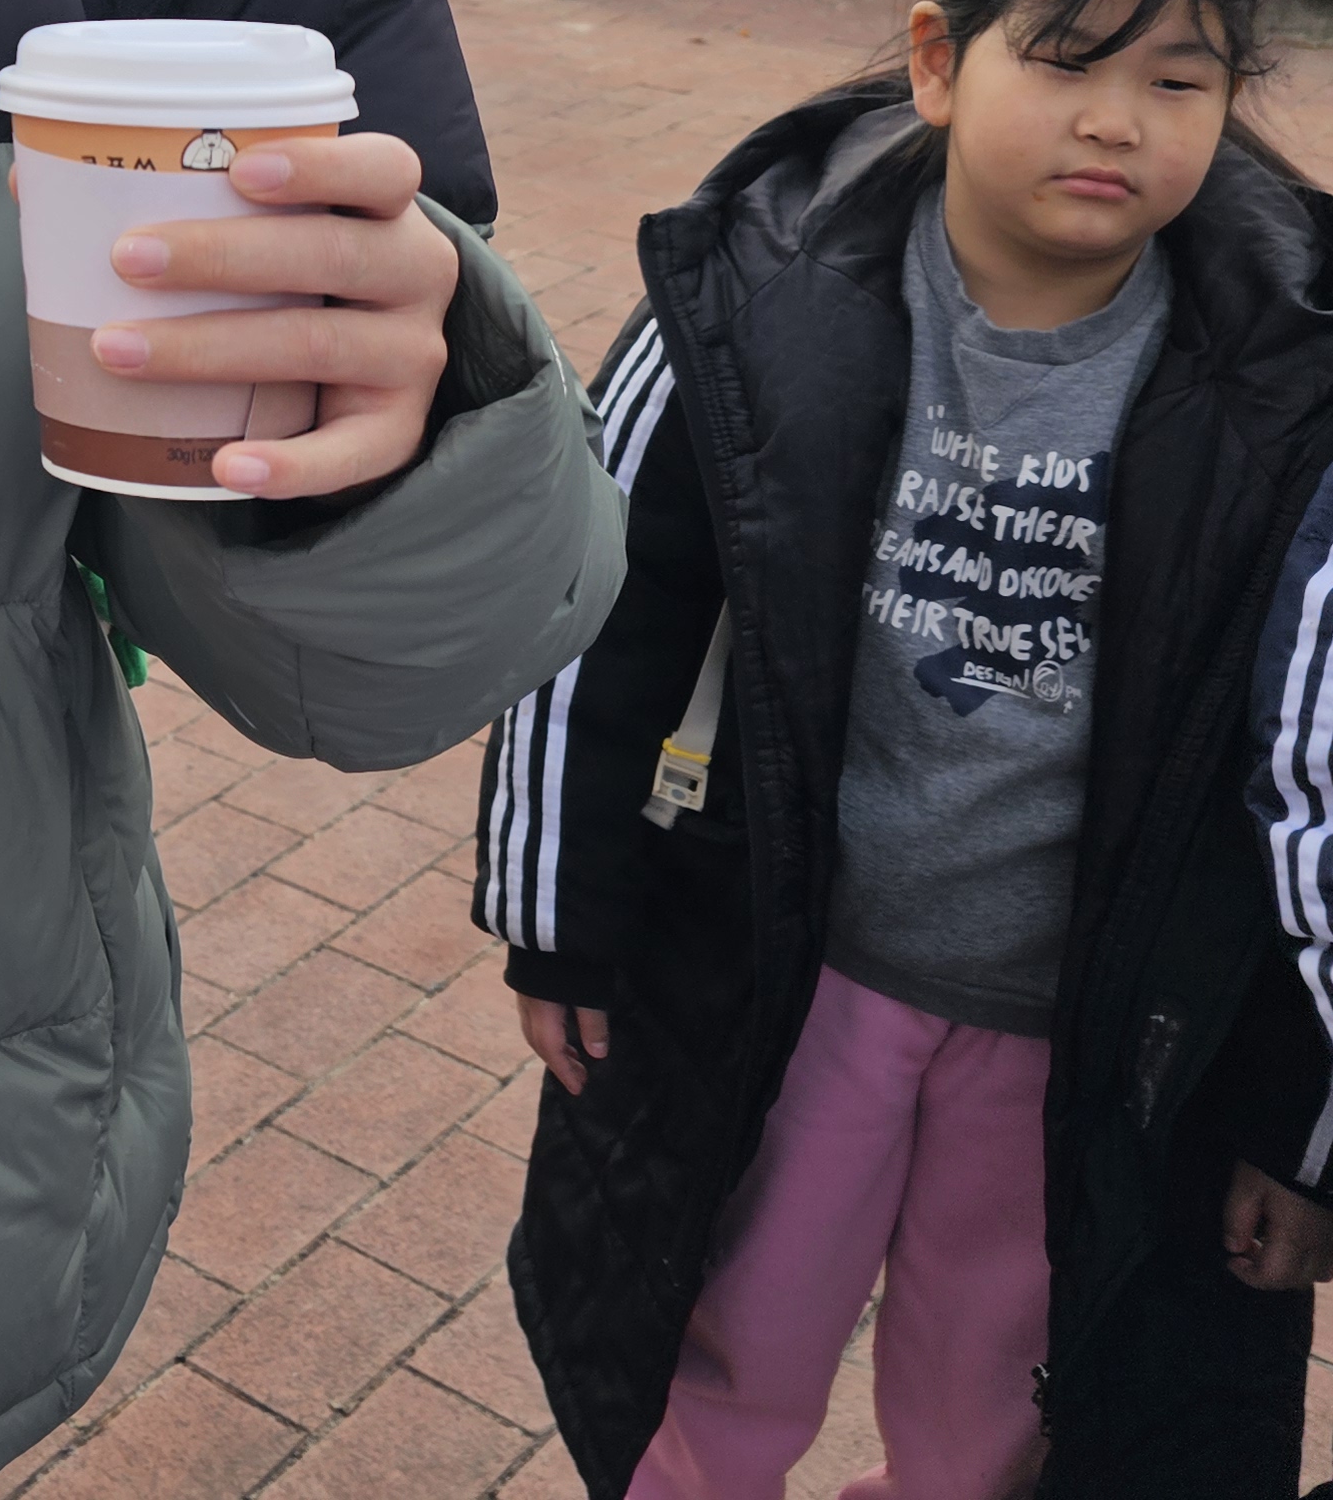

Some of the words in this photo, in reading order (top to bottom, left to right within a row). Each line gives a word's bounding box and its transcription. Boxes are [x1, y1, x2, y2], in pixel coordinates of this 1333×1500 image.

[1016, 451, 1093, 493] KIDS
[896, 469, 986, 531] RAISE
[991, 504, 1097, 557] THEIR
[941, 547, 993, 591] AND
[952, 607, 1034, 660] TRUE
